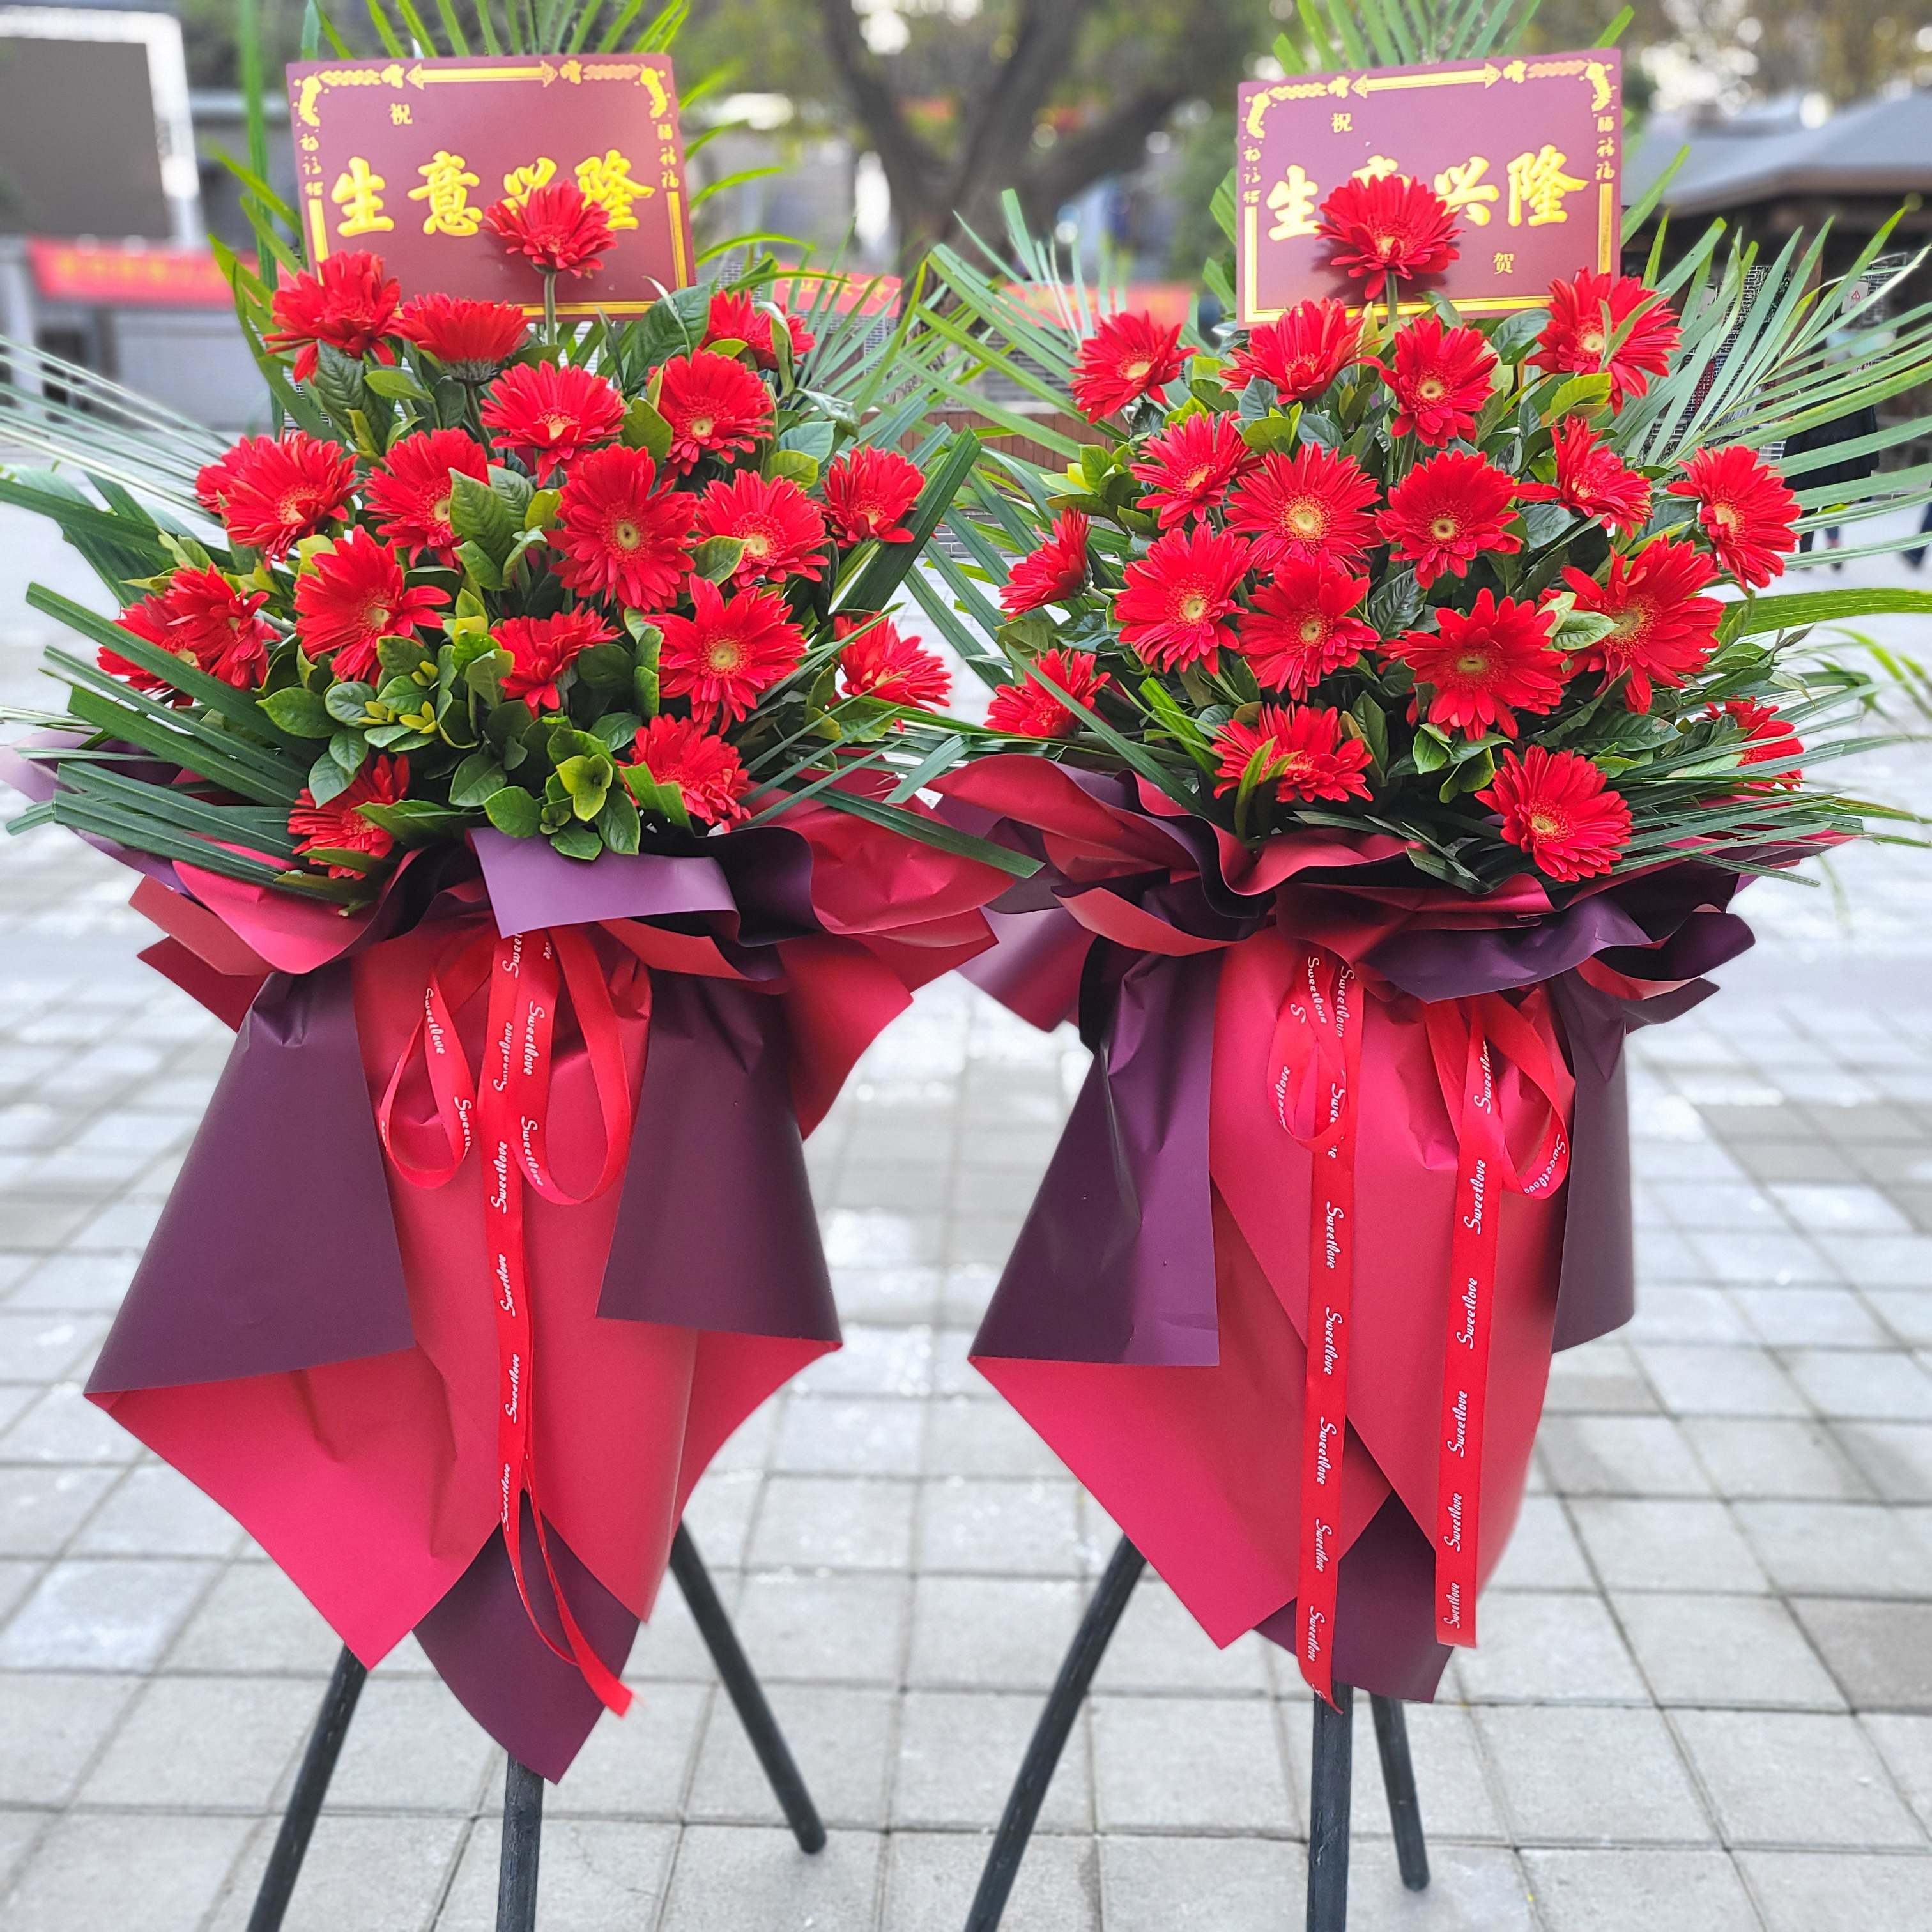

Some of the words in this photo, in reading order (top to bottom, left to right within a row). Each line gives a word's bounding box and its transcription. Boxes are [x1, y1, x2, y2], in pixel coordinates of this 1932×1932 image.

[389, 102, 413, 125] 祝
[1331, 112, 1353, 133] 祝
[1267, 144, 1589, 241] 生兴隆
[1492, 252, 1515, 275] 贺
[524, 1000, 546, 1076] Sweetlove
[490, 1141, 508, 1214] Sweetlove
[1464, 1160, 1487, 1235] Sweetlove
[1326, 1201, 1344, 1269] Sweetlove
[496, 1254, 516, 1317] Sweetlove
[1457, 1277, 1478, 1351] Sweetlove
[1324, 1307, 1344, 1376] Sweetlove
[505, 1354, 520, 1423] Sweetlove
[1317, 1416, 1338, 1485] Sweetlove
[1447, 1390, 1468, 1458] Sweetlove
[1315, 1519, 1333, 1572] Sweetlove
[1443, 1492, 1462, 1552] Sweetlove
[1308, 1606, 1326, 1662] Sweetlove
[1443, 1583, 1460, 1629] Sweetlove
